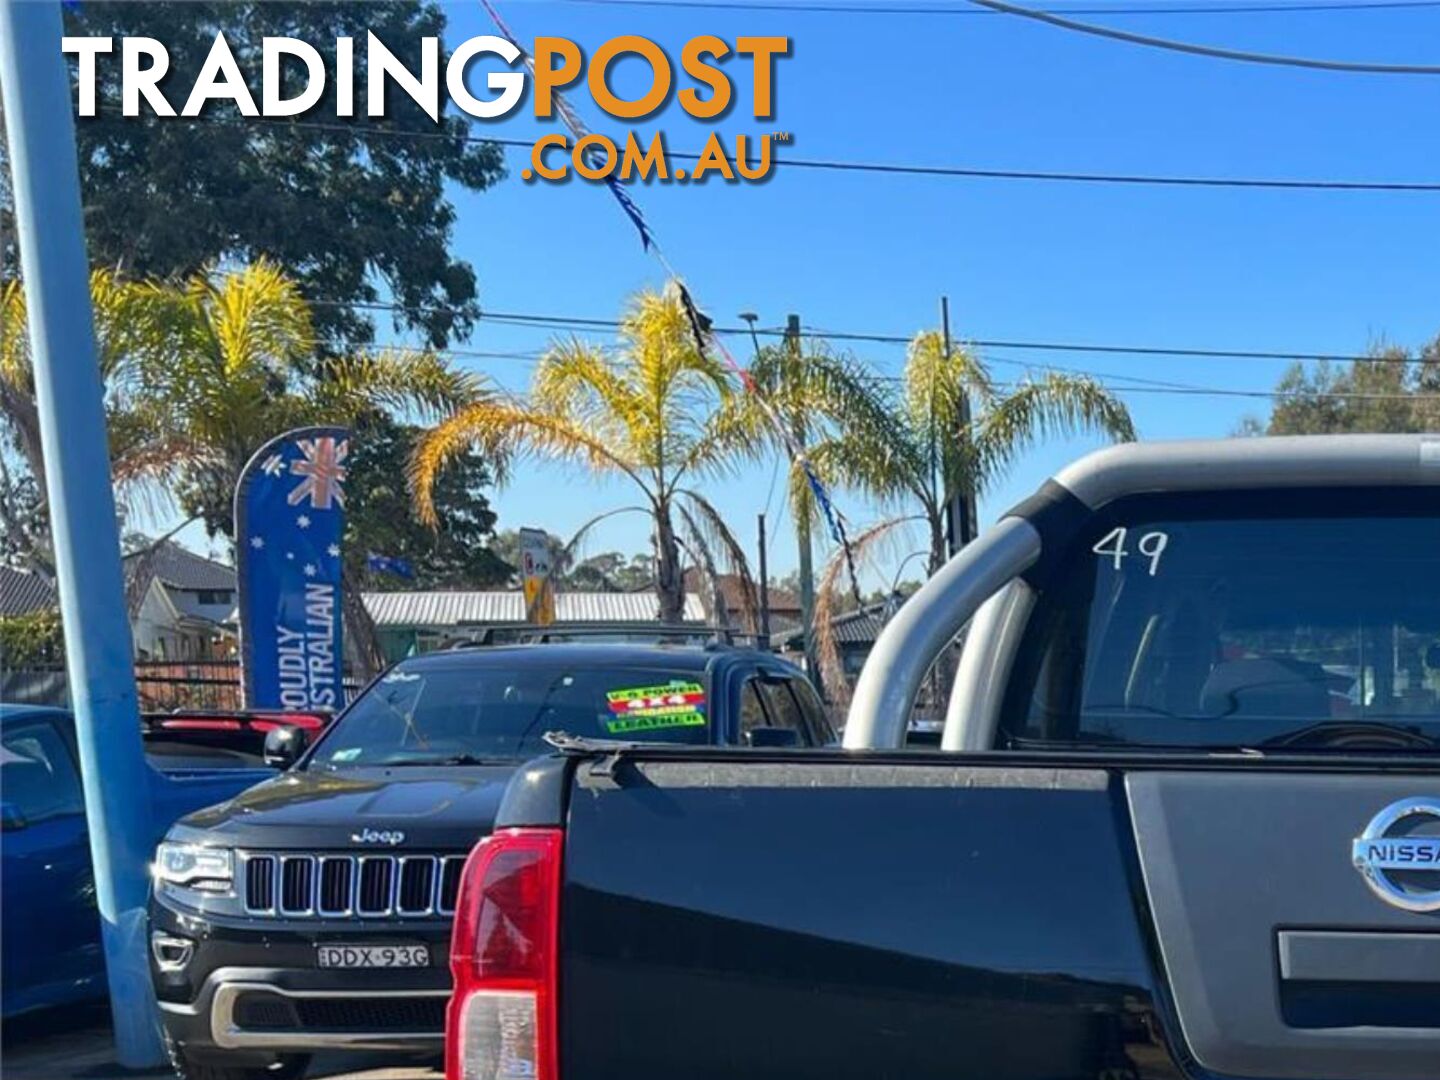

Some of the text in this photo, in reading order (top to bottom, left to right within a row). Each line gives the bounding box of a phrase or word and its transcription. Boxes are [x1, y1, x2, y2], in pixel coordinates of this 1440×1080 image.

[1092, 527, 1168, 576] 49
[614, 714, 698, 729] LEATHER
[351, 828, 405, 846] Jeep
